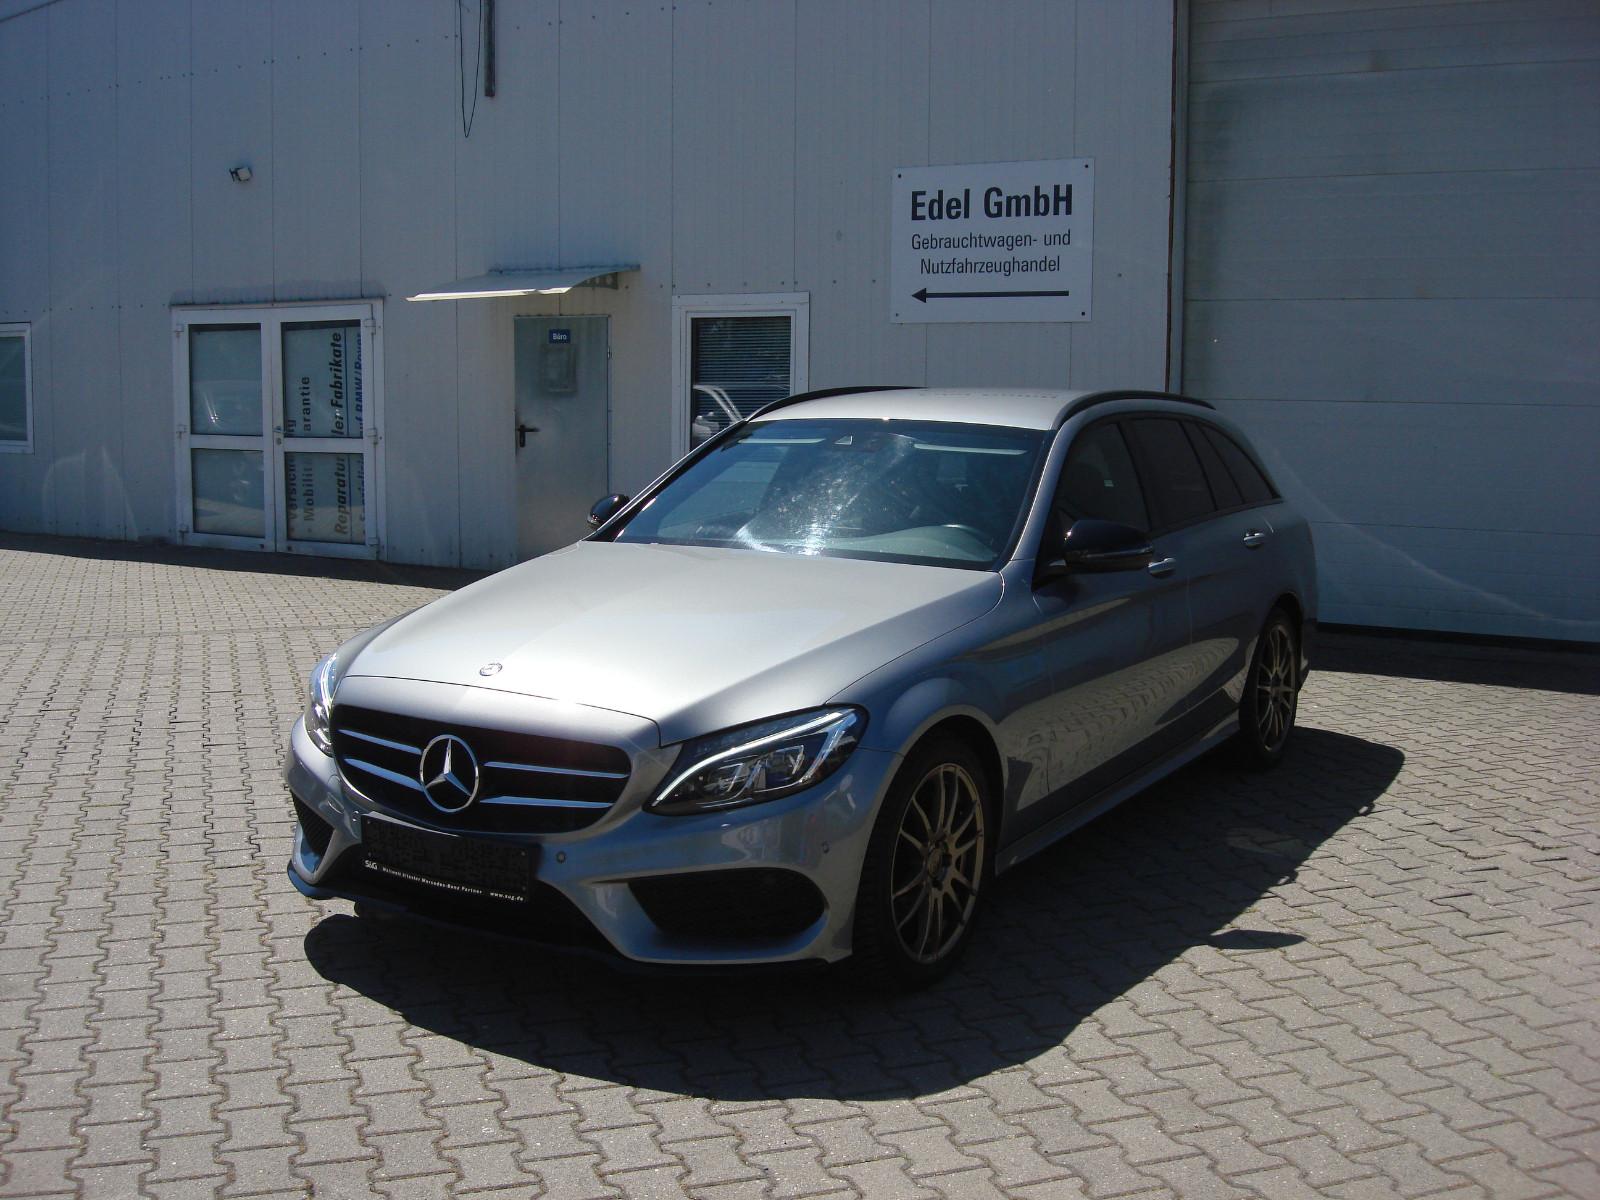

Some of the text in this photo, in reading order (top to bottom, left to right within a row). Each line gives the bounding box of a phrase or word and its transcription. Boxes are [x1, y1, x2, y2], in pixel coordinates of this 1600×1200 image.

[911, 184, 1073, 221] Edel GmbH
[911, 229, 1071, 251] Gebrauchtwagen- und
[920, 255, 1061, 276] Nutzfahrzeughandel
[328, 332, 344, 409] Fabrikate
